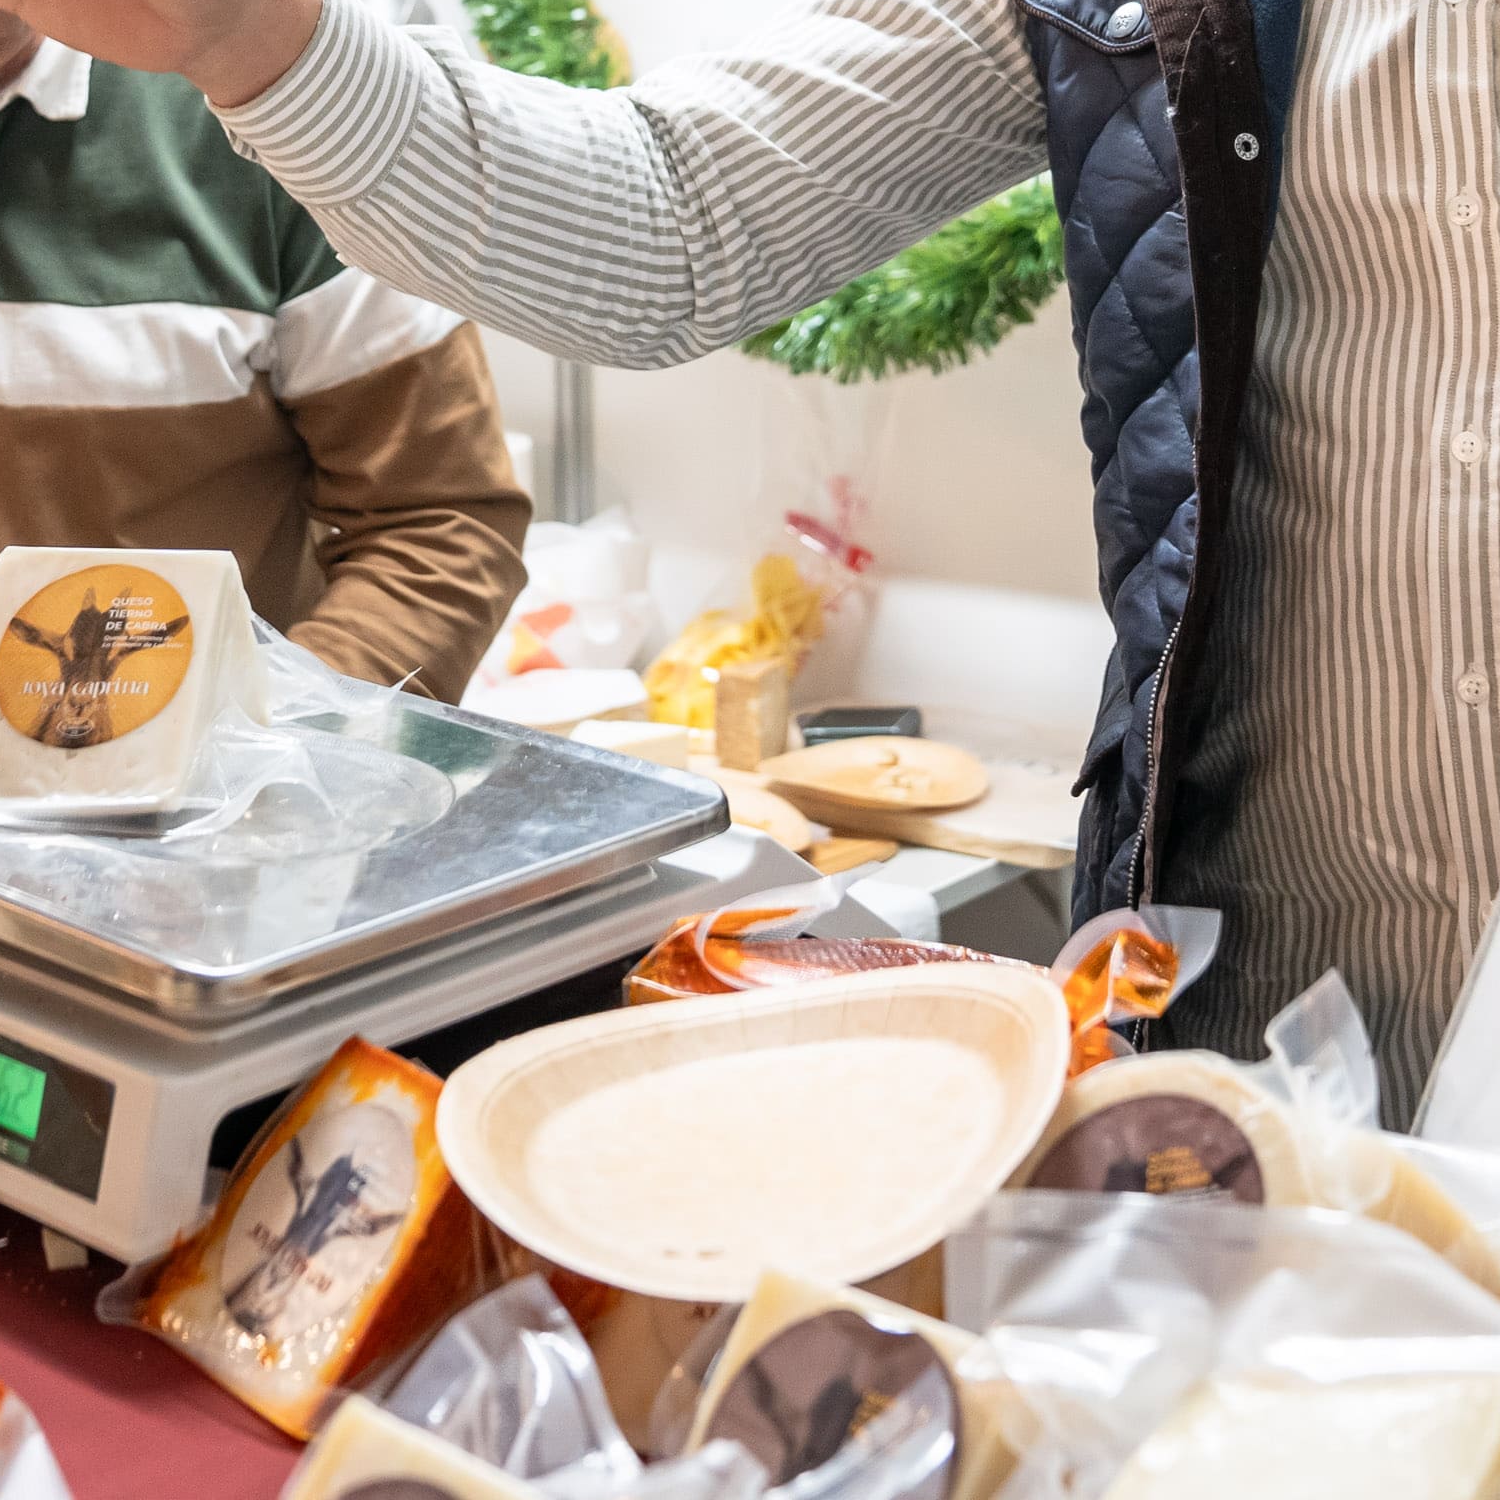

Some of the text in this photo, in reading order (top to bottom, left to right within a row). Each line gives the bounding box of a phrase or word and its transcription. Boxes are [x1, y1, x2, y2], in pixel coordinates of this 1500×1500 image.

[111, 597, 154, 607] QUESO
[108, 609, 154, 619] TIERNO
[105, 621, 168, 631] DE CABRA
